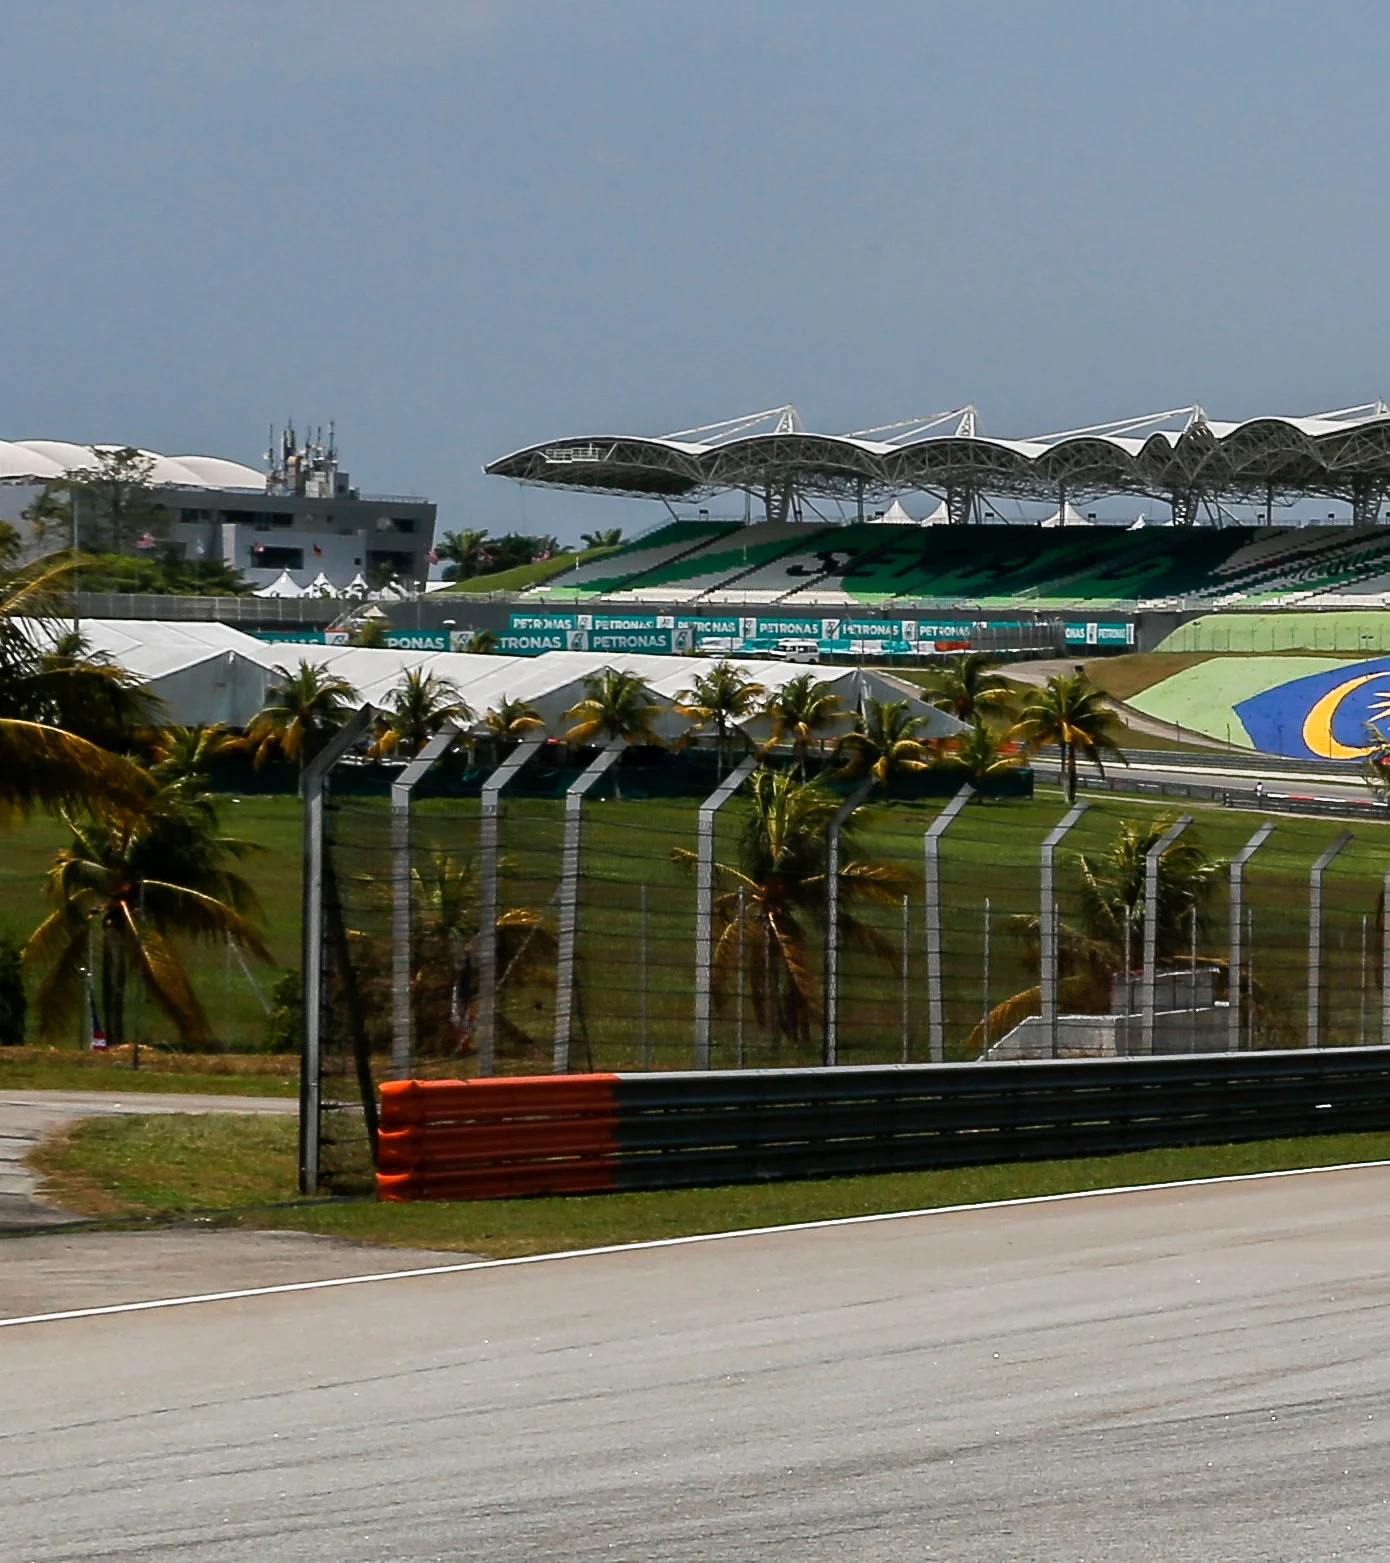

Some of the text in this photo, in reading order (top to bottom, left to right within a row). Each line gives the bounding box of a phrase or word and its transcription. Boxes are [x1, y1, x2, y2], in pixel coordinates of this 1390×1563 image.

[595, 619, 655, 630] PETRONAS
[760, 622, 819, 634] PETRONAS
[920, 625, 971, 637] PETRONAS
[1065, 627, 1085, 639] ONAS
[493, 636, 562, 649] TRONAS
[593, 635, 667, 648] PETRONAS
